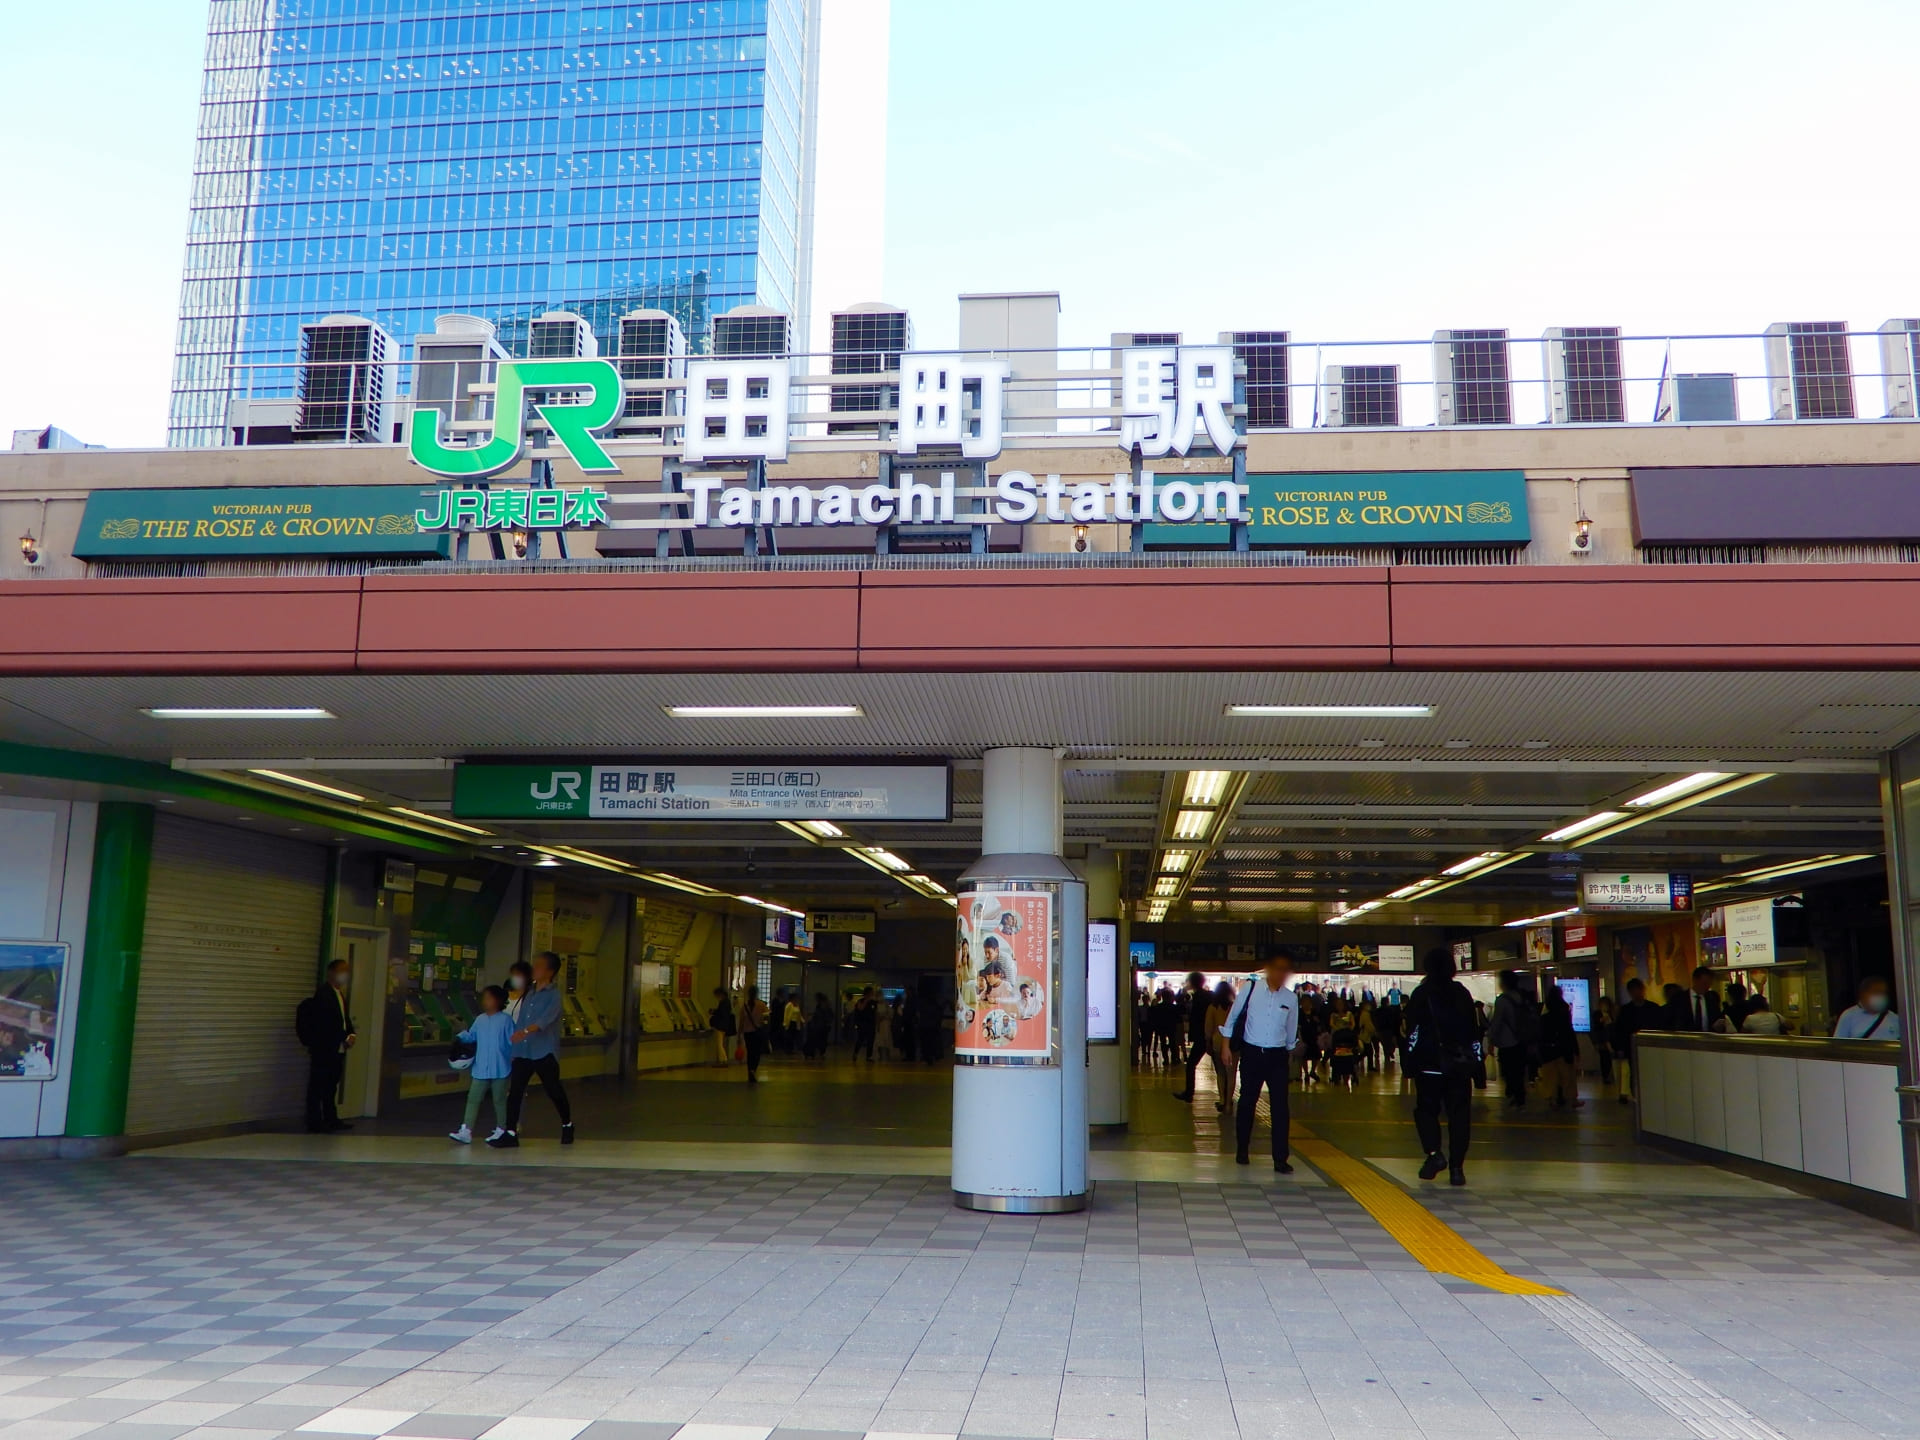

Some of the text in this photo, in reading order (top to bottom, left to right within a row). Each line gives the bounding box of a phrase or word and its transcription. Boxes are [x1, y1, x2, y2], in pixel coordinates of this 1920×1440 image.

[683, 346, 1238, 463] 田町駅
[409, 358, 626, 475] JR
[682, 470, 1241, 526] Tamachi Station
[1275, 490, 1388, 502] VICTORIAN PUB
[212, 503, 312, 515] VICTORIAN PUB
[415, 487, 609, 531] JR東日本
[1262, 506, 1330, 526] ROSE
[1336, 507, 1356, 525] &
[1360, 504, 1464, 525] CROWN
[142, 517, 376, 539] THE ROSE & CROWN
[530, 771, 582, 800] JR
[599, 772, 676, 793] 田町駅
[599, 797, 710, 810] Tamachi Station
[729, 789, 863, 798] Mita Entrance (West Entrance)
[536, 802, 574, 811] JR東日本
[1609, 895, 1648, 904] クリニック
